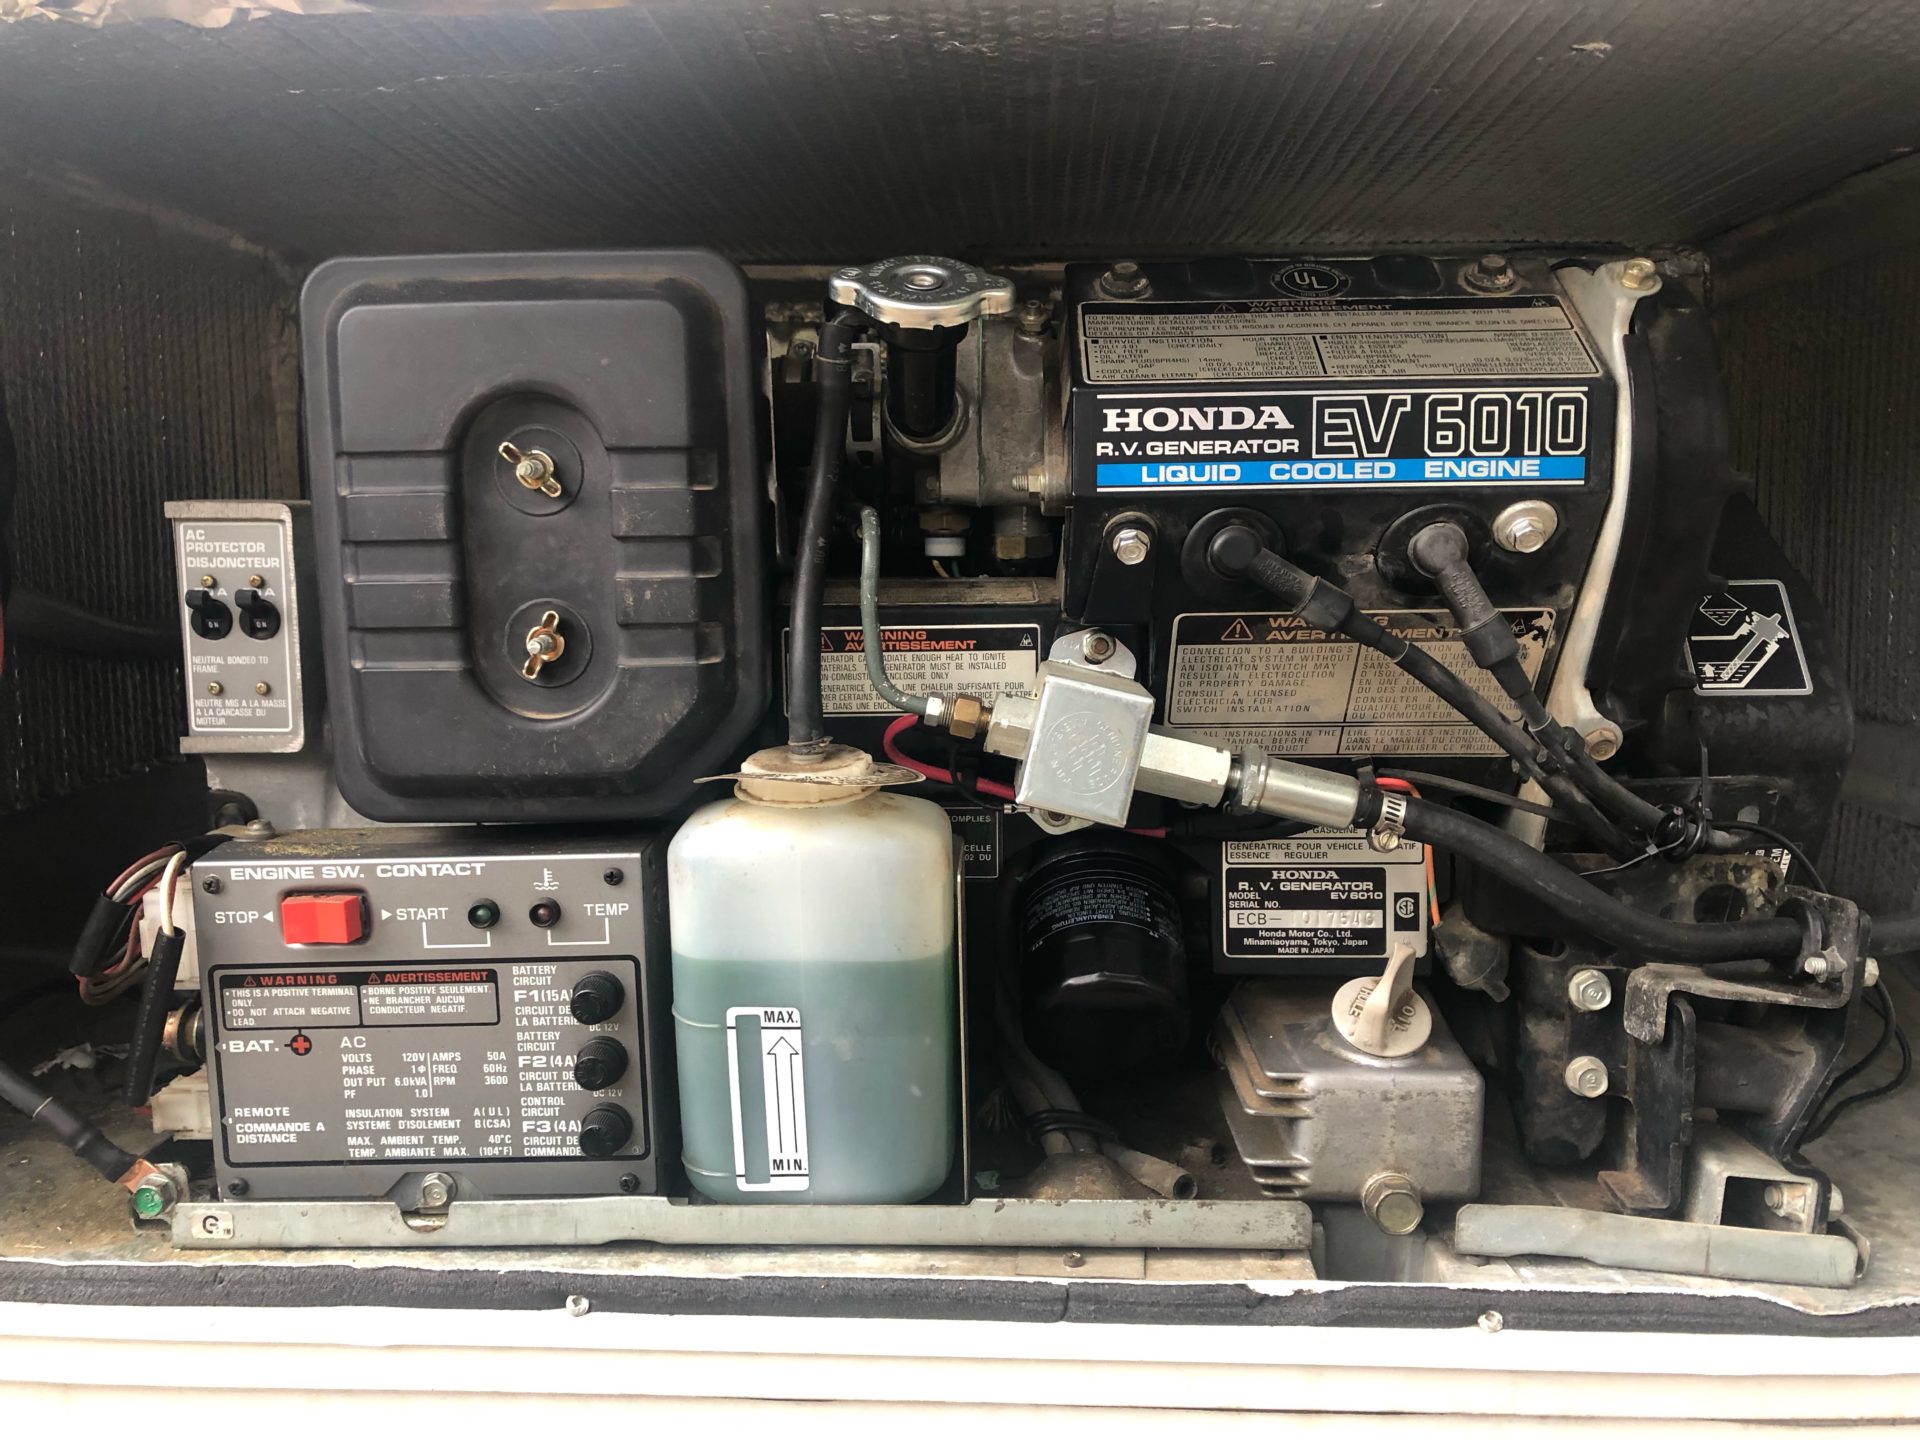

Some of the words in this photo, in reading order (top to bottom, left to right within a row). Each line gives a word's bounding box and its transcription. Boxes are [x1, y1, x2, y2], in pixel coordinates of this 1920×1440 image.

[1102, 405, 1295, 432] HONDA
[1312, 395, 1411, 459] EV
[1424, 392, 1588, 457] 6010
[1096, 441, 1142, 456] R.V.
[1146, 438, 1299, 455] GENERATOR
[1141, 464, 1241, 483] LIQUID
[1270, 461, 1396, 481] COOLED
[1424, 459, 1540, 478] ENGINE
[185, 529, 205, 540] AC
[186, 541, 266, 553] PROTECTOR
[186, 557, 280, 568] DISJONCTEUR
[1182, 646, 1251, 655] CONNECTION
[192, 655, 225, 664] NEUTRAL
[227, 655, 256, 664] BONDED
[912, 653, 941, 662] ENOUGH
[946, 653, 963, 661] HEAT
[969, 652, 978, 661] TO
[982, 652, 1006, 661] IGNITE
[1181, 655, 1245, 664] ELECTRICAL
[1251, 654, 1294, 663] SYSTEM
[1301, 653, 1352, 662] WITHOUT
[930, 662, 951, 670] MUST
[955, 662, 964, 670] BE
[968, 661, 1007, 670] INSTALLED
[1201, 663, 1259, 671] ISOLATION
[1264, 662, 1308, 671] SWITCH
[1313, 662, 1338, 670] MAY
[930, 671, 949, 680] ONLY
[1179, 672, 1218, 680] RESULT
[1248, 671, 1335, 679] ELECTROCUTION
[920, 682, 953, 691] CHALEUR
[957, 681, 1000, 690] SUFFISANTE
[1004, 681, 1024, 690] POUR
[839, 693, 873, 701] CERTAINS
[1177, 689, 1225, 698] CONSULT
[1247, 689, 1297, 697] LICENSED
[195, 699, 223, 708] NEUTRE
[261, 699, 287, 708] MASSE
[1176, 705, 1218, 713] SWITCH
[1227, 704, 1311, 713] INSTALLATION
[216, 708, 253, 716] CARCASSE
[951, 815, 991, 823] OMPLIES
[1229, 842, 1291, 851] GENERATRICE
[1296, 842, 1322, 850] POUR
[1326, 842, 1363, 850] VEHICLE
[1229, 851, 1271, 859] ESSENCE
[1284, 851, 1328, 859] REGULIER
[230, 867, 315, 881] ENGINE
[322, 866, 365, 879] SW.
[376, 863, 486, 878] CONTACT
[1271, 870, 1340, 880] HONDA
[1279, 881, 1373, 891] GENERATOR
[1229, 892, 1261, 900] MODEL
[1350, 891, 1383, 900] 6010
[584, 903, 629, 916] TEMP
[1264, 901, 1281, 909] NO.
[214, 911, 260, 924] STOP
[396, 907, 448, 921] START
[1258, 930, 1286, 938] Honda
[1288, 930, 1315, 938] Motor
[1336, 930, 1353, 938] Ltd.
[1312, 938, 1340, 946] Tokyo,
[1342, 938, 1368, 947] Japan
[512, 965, 557, 975] BATTERY
[260, 974, 338, 986] WARNING
[384, 971, 488, 983] AVERTISSEMENT
[513, 976, 552, 986] CIRCUIT
[232, 989, 251, 998] THIS
[272, 988, 309, 997] POSITIVE
[312, 987, 354, 996] TERMINAL
[368, 987, 396, 996] BORNE
[399, 986, 436, 995] POSITIVE
[514, 990, 540, 1002] F1
[369, 997, 380, 1005] NE
[386, 996, 431, 1004] BRANCHER
[436, 995, 465, 1004] AUCUN
[232, 1008, 244, 1017] DO
[250, 1007, 267, 1016] NOT
[273, 1007, 305, 1016] ATTACH
[311, 1006, 351, 1015] NEGATIVE
[370, 1005, 425, 1014] CONDUCTEUR
[515, 1006, 555, 1015] CIRCUIT
[559, 1005, 571, 1015] DE
[516, 1017, 528, 1026] LA
[763, 1010, 798, 1023] MAX.
[604, 1023, 619, 1032] 12V
[516, 1032, 560, 1041] BATTERY
[228, 1040, 279, 1053] BAT.
[340, 1036, 367, 1048] AC
[517, 1042, 556, 1052] CIRCUIT
[342, 1053, 372, 1063] VOLTS
[402, 1053, 425, 1062] 120V
[432, 1052, 462, 1062] AMPS
[487, 1052, 507, 1061] 50A
[518, 1056, 547, 1067] F2
[342, 1066, 375, 1075] PHASE
[433, 1065, 458, 1074] FREQ
[483, 1064, 507, 1073] 60Hz
[343, 1077, 363, 1087] OUT
[366, 1077, 385, 1086] PUT
[395, 1076, 427, 1086] 6.0kVA
[434, 1077, 456, 1086] RPM
[484, 1075, 508, 1085] 3600
[519, 1072, 559, 1081] CIRCUIT
[563, 1071, 575, 1080] DE
[344, 1090, 356, 1099] PF
[608, 1089, 623, 1097] 12V
[520, 1096, 566, 1106] CONTROL
[234, 1107, 290, 1117] REMOTE
[345, 1108, 403, 1118] INSULATION
[410, 1107, 450, 1117] SYSTEM
[521, 1107, 560, 1117] CIRCUIT
[236, 1122, 310, 1133] COMMANDE
[346, 1120, 391, 1130] SYSTEME
[398, 1119, 462, 1129] D'ISOLEMENT
[522, 1121, 551, 1133] F3
[554, 1120, 582, 1133] (4A)
[236, 1133, 298, 1144] DISTANCE
[347, 1136, 373, 1146] MAX.
[380, 1135, 425, 1145] AMBIENT
[432, 1135, 462, 1144] TEMP.
[523, 1136, 562, 1146] CIRCUIT
[566, 1136, 579, 1145] DE
[348, 1148, 378, 1158] TEMP.
[385, 1147, 436, 1157] AMBIANTE
[443, 1147, 470, 1156] MAX.
[524, 1147, 582, 1157] COMMANDE
[773, 1159, 807, 1171] MIN.
